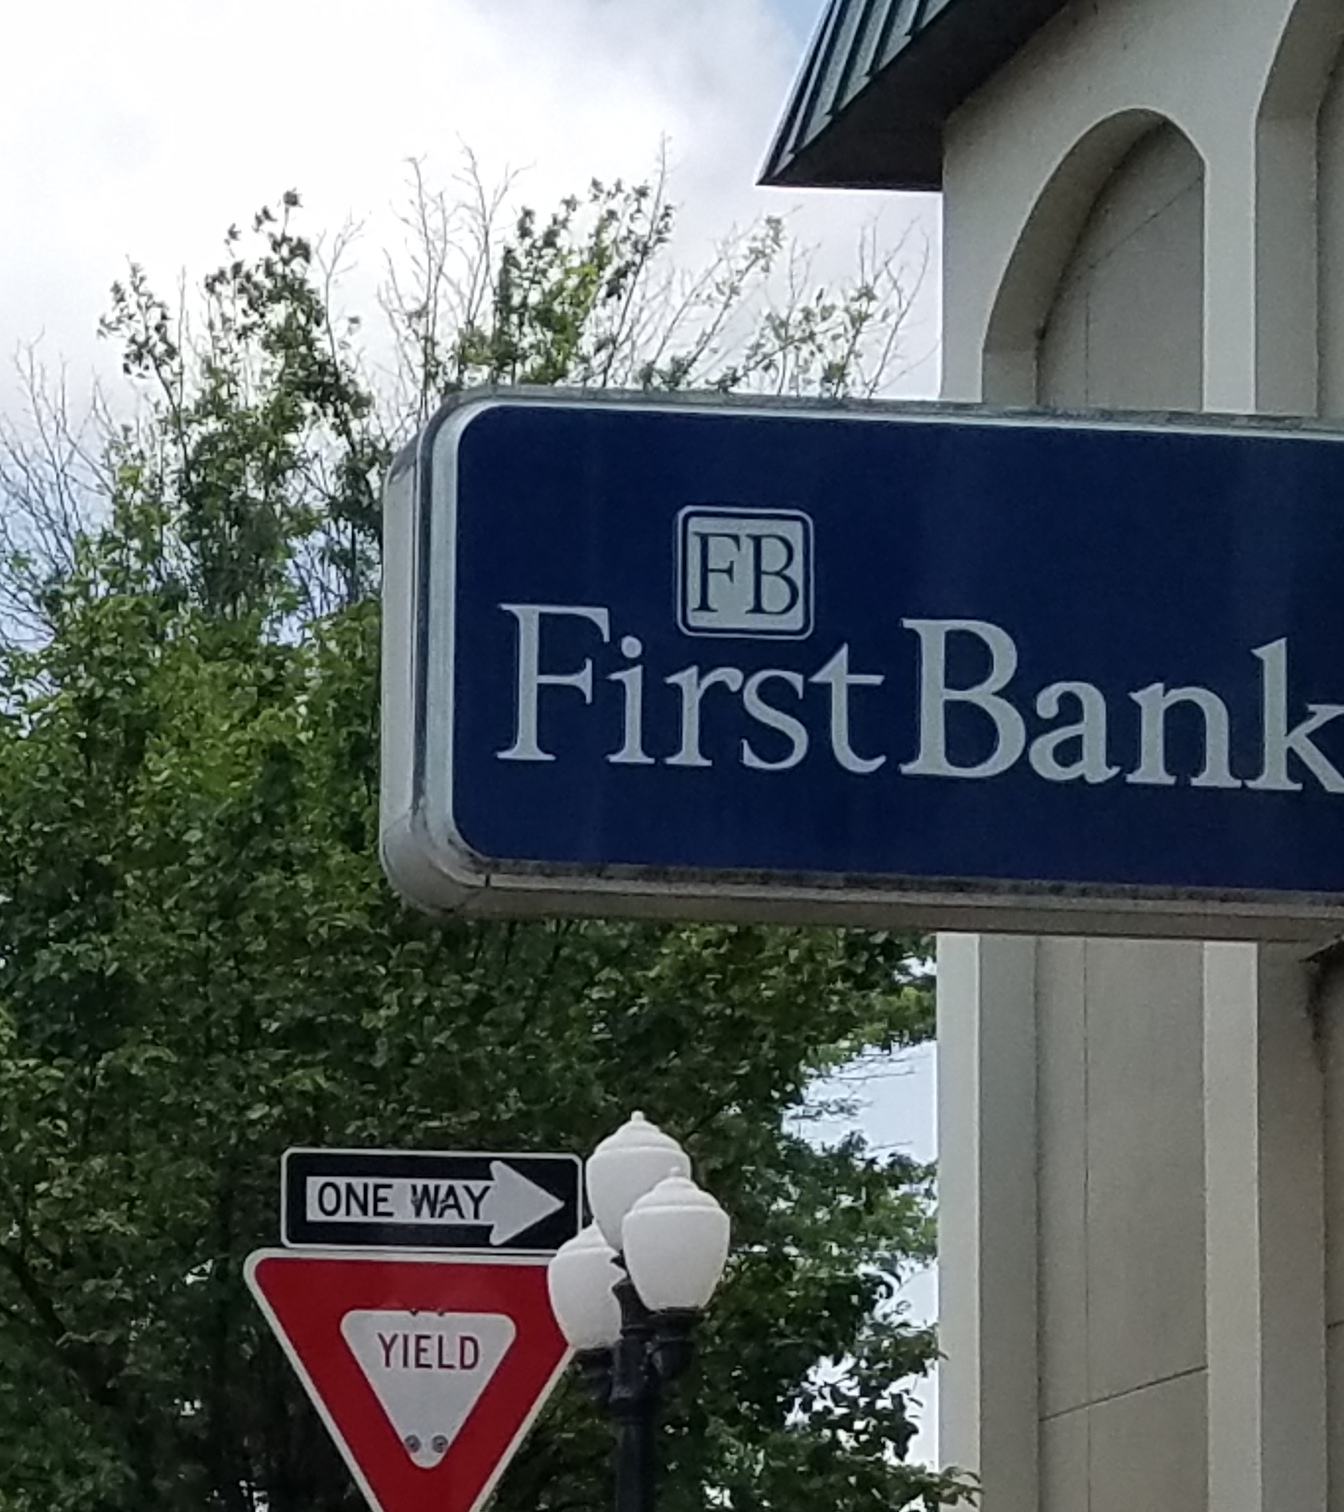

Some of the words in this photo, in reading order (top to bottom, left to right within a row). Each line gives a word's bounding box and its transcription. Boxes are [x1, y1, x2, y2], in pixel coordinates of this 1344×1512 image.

[689, 528, 803, 617] FB
[317, 1181, 394, 1217] ONE
[411, 1183, 491, 1220] WAY
[377, 1332, 480, 1371] YIELD
